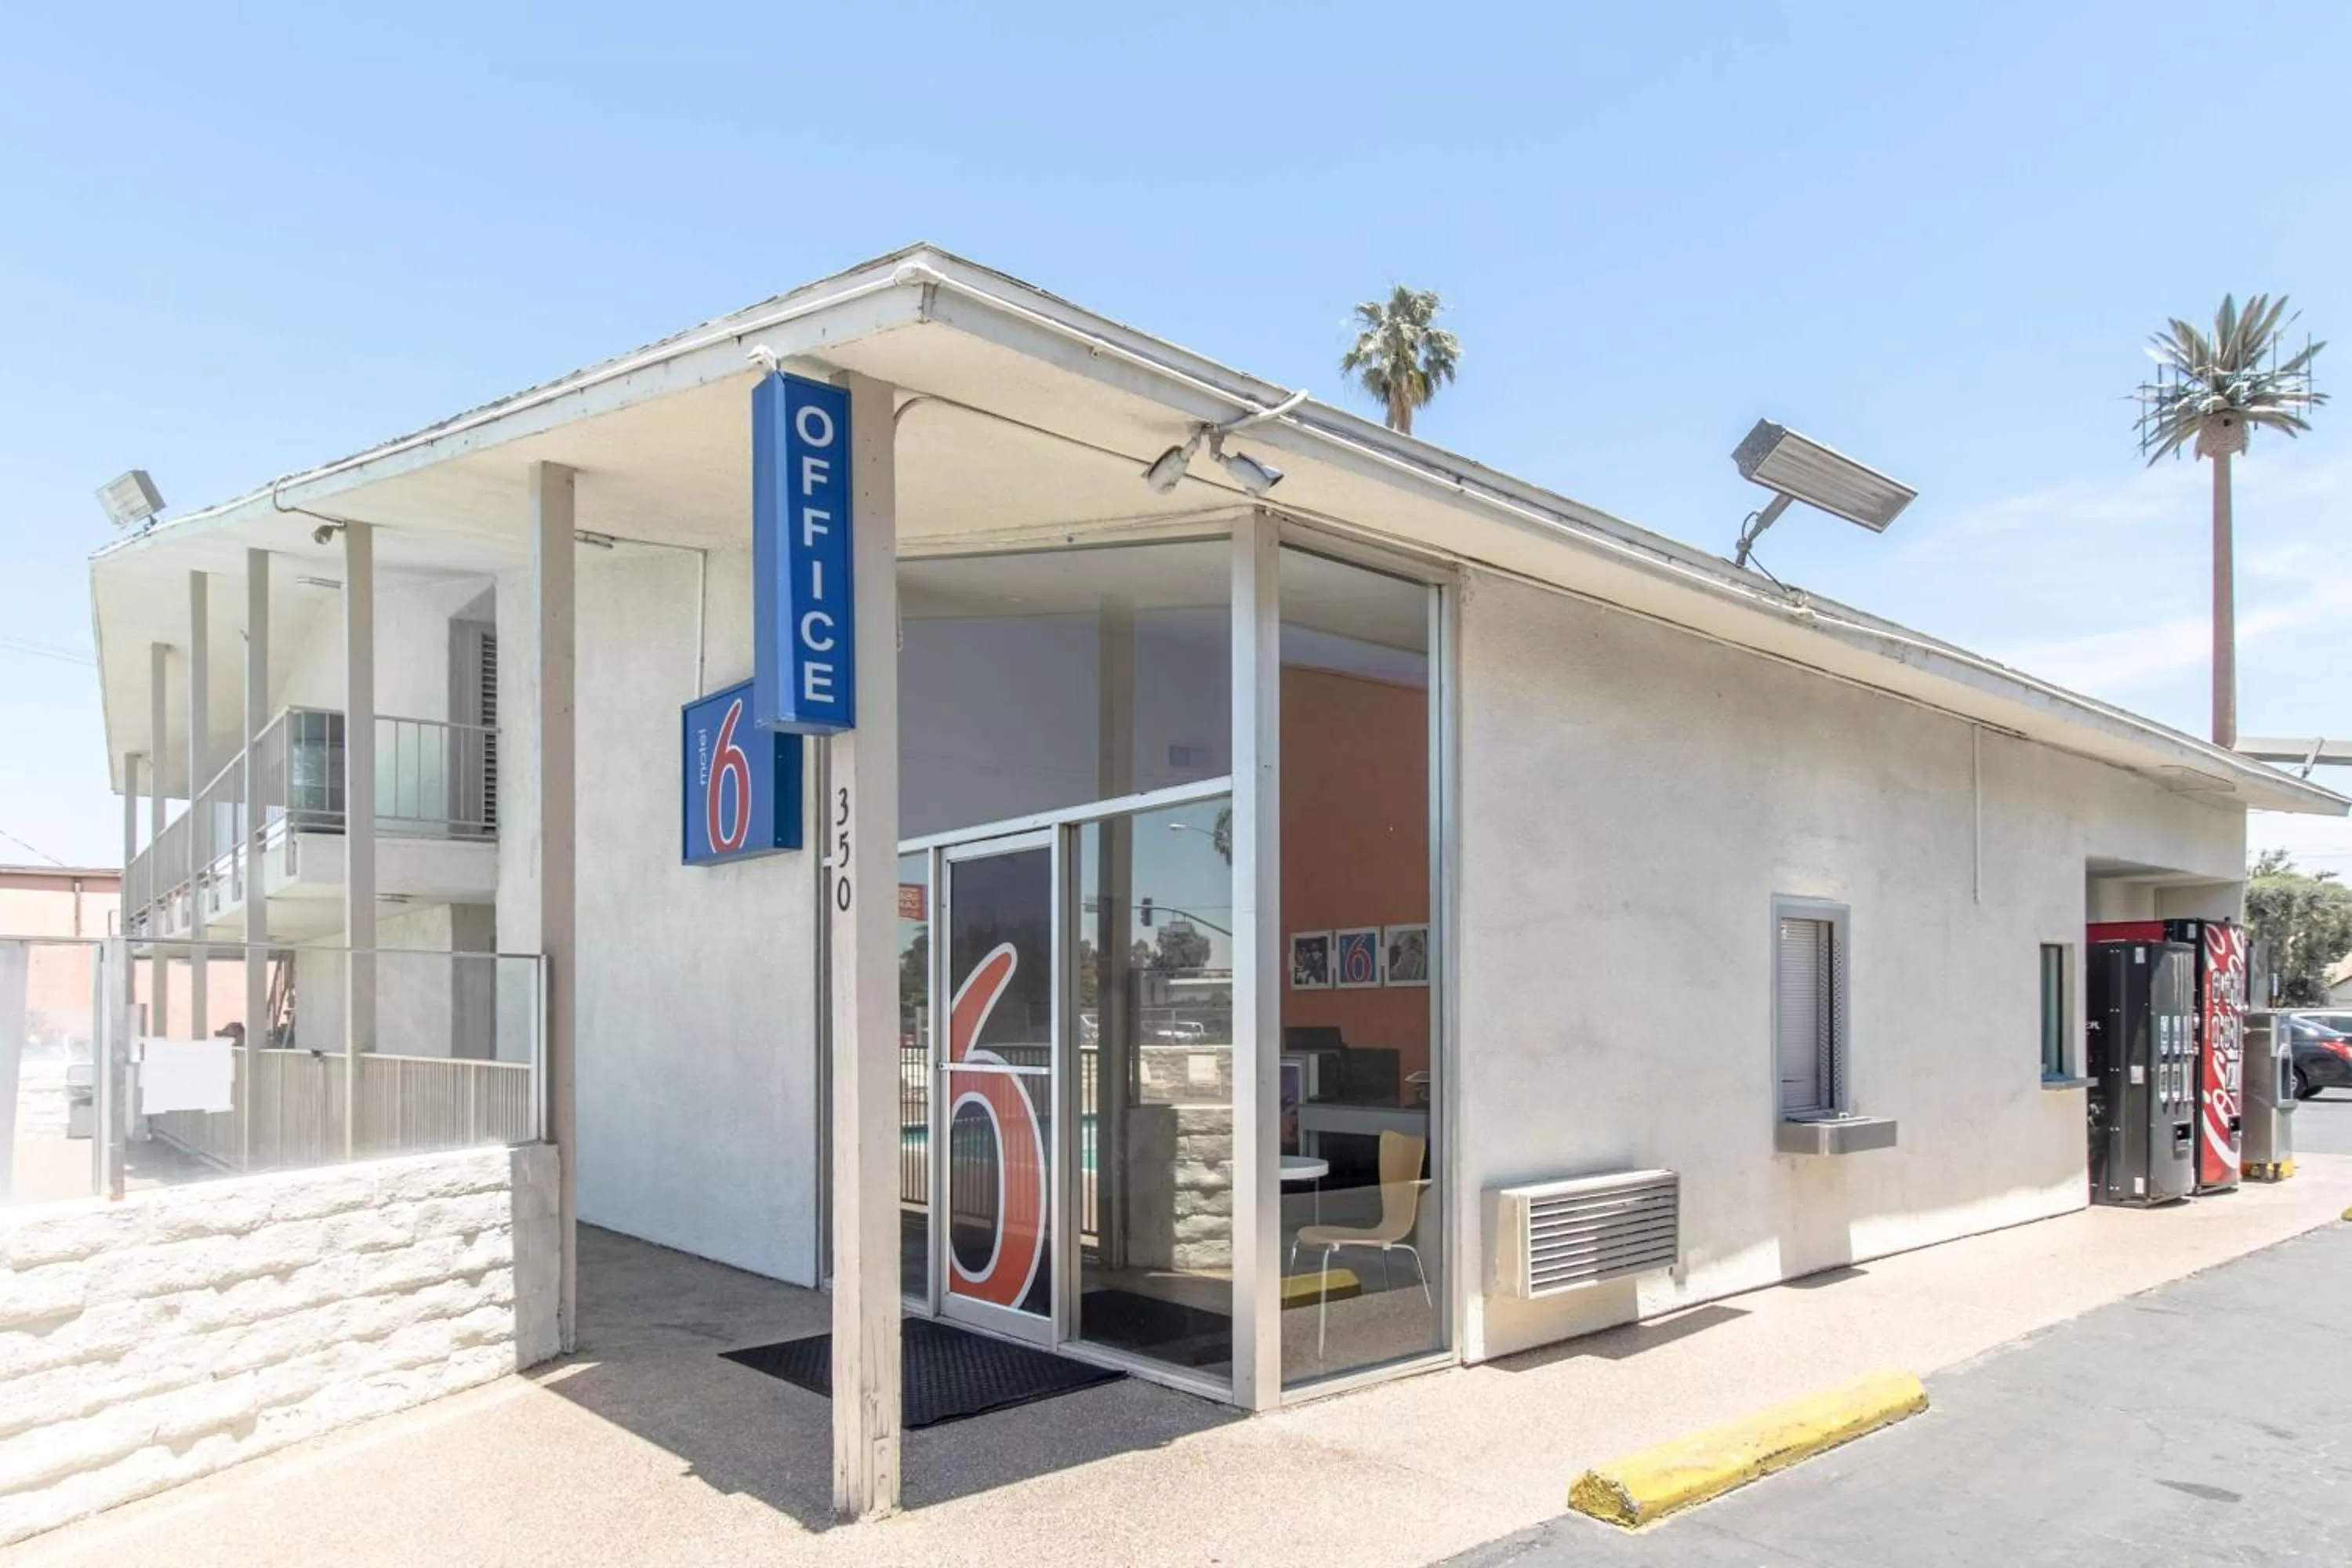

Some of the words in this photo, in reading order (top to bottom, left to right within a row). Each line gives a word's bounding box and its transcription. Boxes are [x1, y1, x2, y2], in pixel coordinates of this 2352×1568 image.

[796, 405, 834, 702] OFFICE
[698, 728, 708, 786] motel
[707, 698, 751, 853] 6
[837, 787, 851, 911] 350
[951, 942, 1045, 1308] 6
